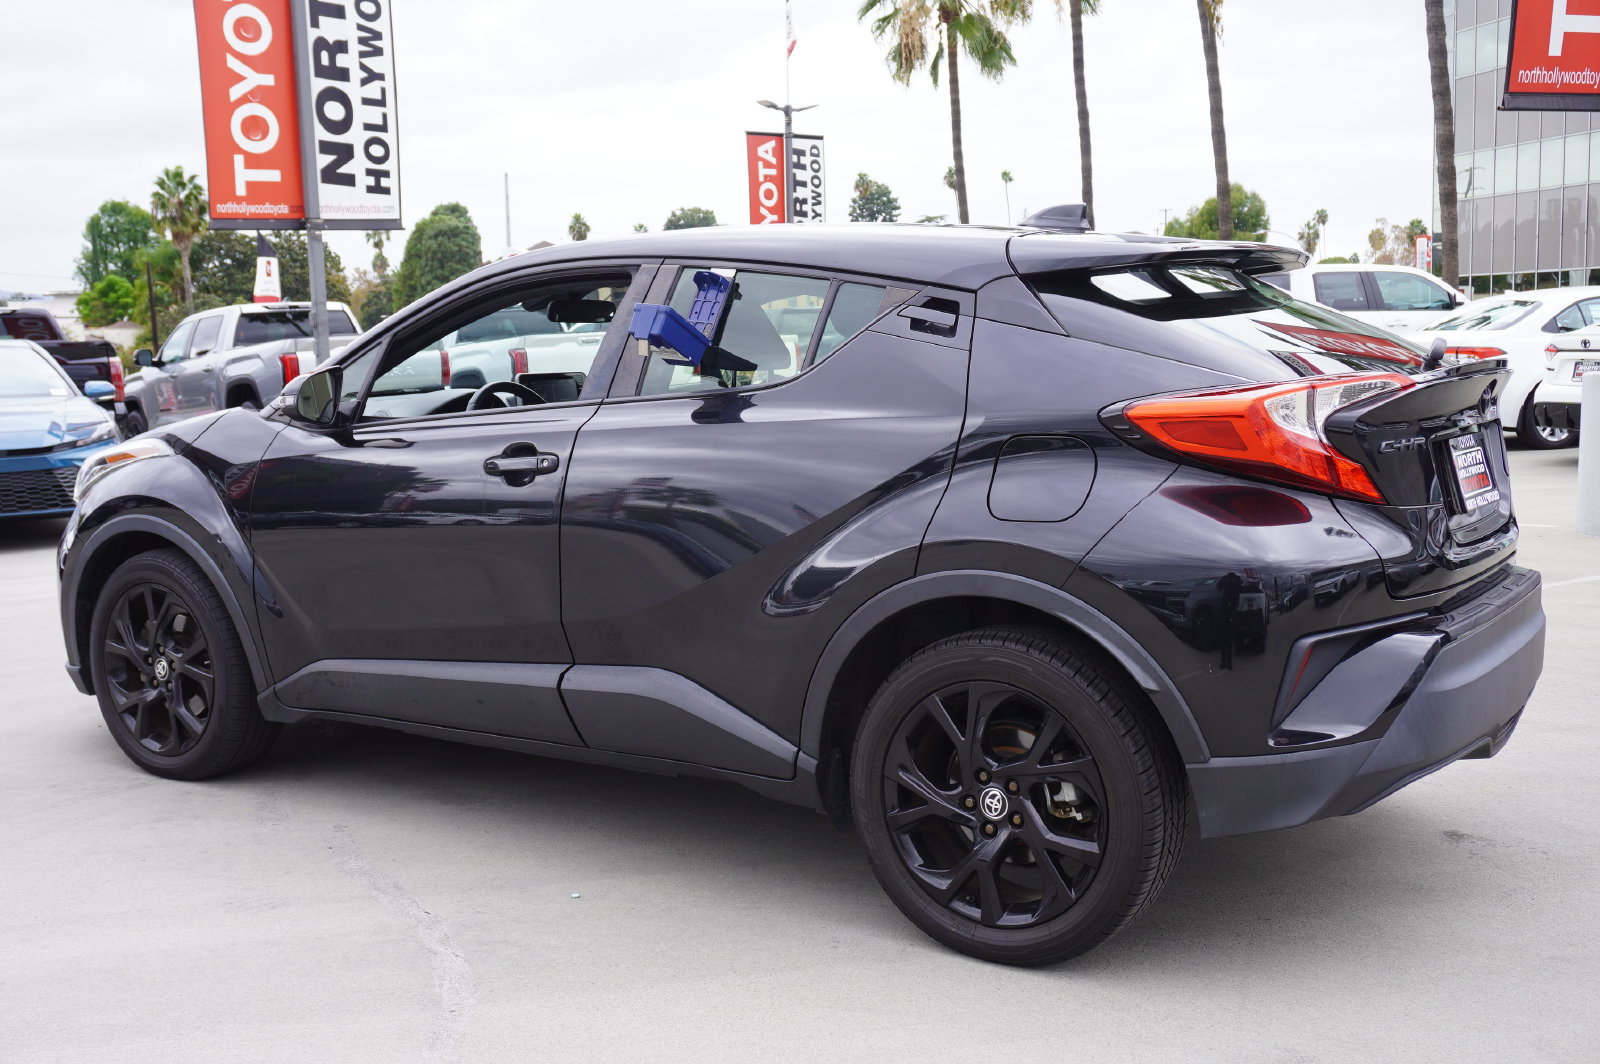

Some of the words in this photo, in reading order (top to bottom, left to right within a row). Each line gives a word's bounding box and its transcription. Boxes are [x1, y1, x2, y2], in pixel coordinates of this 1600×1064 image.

[222, 0, 281, 196] TOYO
[792, 148, 808, 223] RTH
[810, 144, 822, 223] YWOOD
[1457, 450, 1483, 468] NORTH
